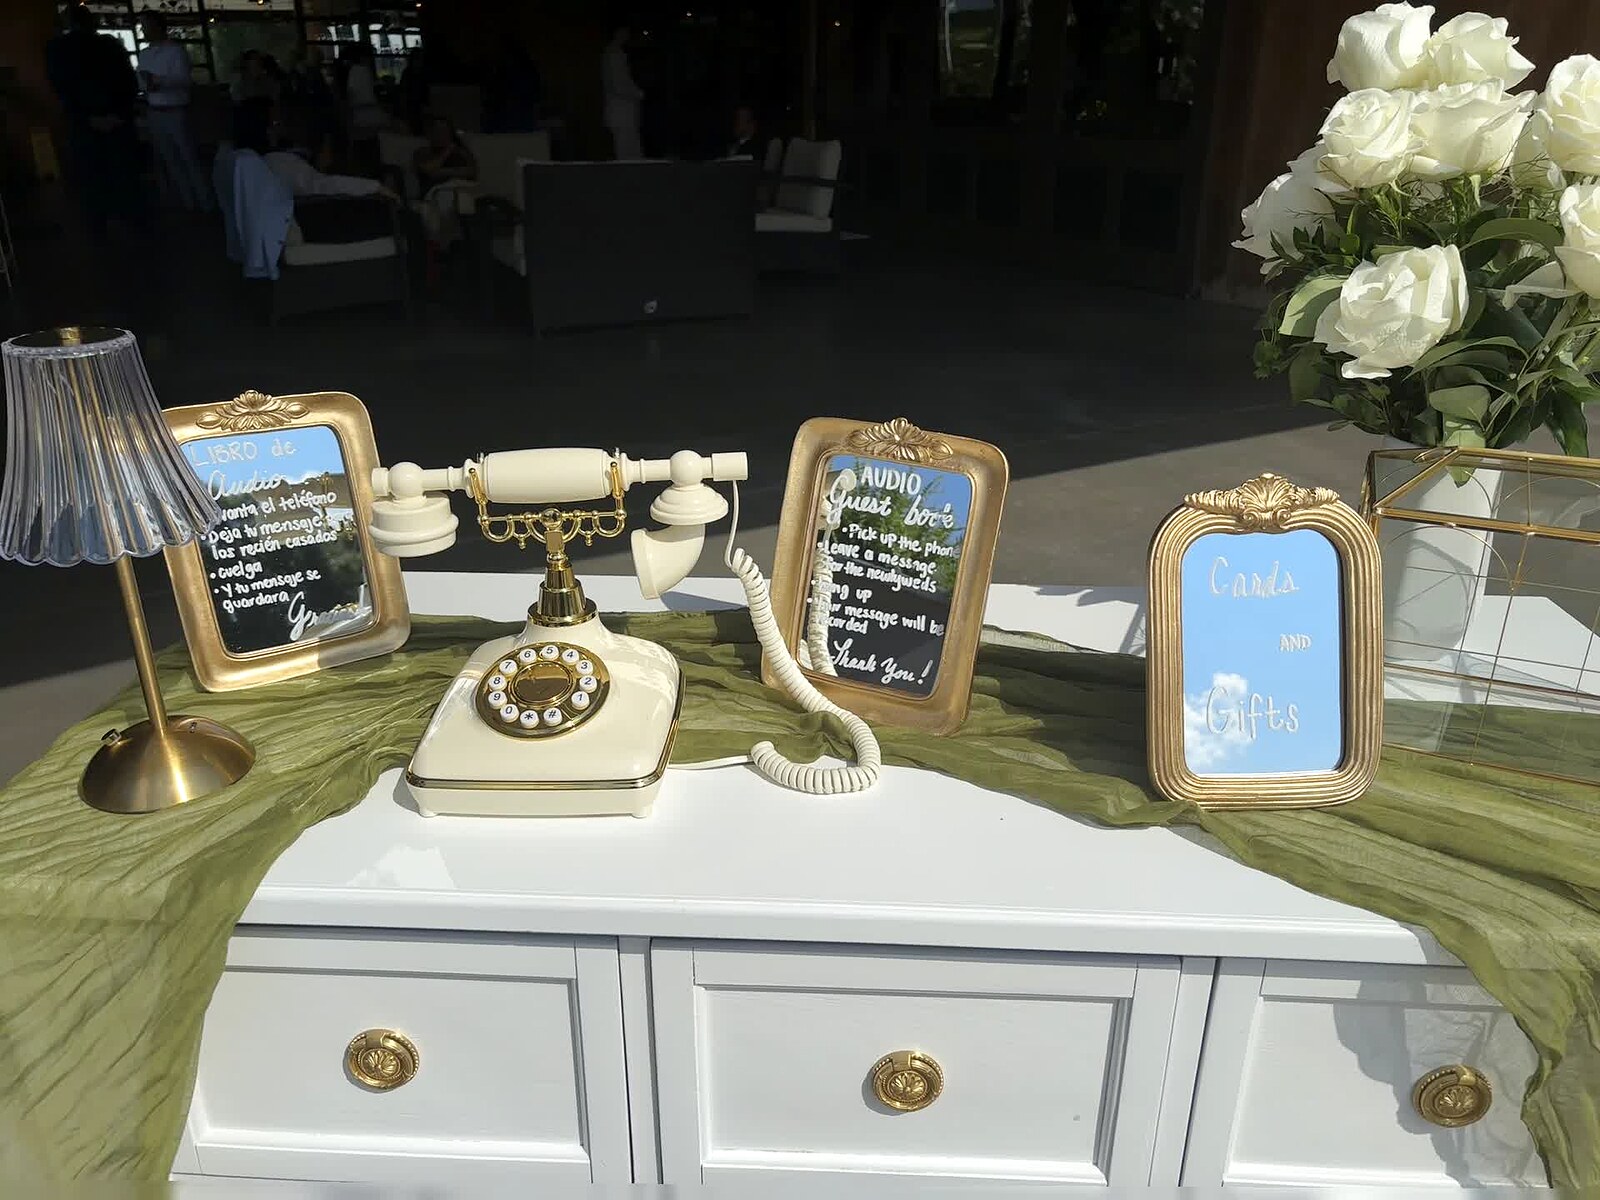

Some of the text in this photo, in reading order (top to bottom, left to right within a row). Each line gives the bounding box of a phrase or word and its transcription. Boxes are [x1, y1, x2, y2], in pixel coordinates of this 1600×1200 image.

[190, 438, 297, 466] LIBRO de
[860, 466, 922, 495] AUDIO
[261, 496, 275, 514] el
[244, 524, 258, 537] tu
[260, 515, 323, 537] mensaje
[211, 545, 236, 560] los
[285, 530, 338, 548] casados
[823, 540, 860, 559] Leave
[864, 549, 874, 561] a
[849, 524, 961, 559] Pick up the phone
[235, 582, 250, 595] tu
[250, 570, 304, 592] mensaje
[306, 569, 321, 581] se
[844, 561, 864, 577] the
[1209, 555, 1300, 599] Cards
[856, 588, 872, 603] up
[844, 605, 898, 629] message
[902, 615, 926, 632] will
[930, 620, 945, 636] be
[831, 638, 876, 672] Thank
[1279, 633, 1312, 652] AND
[1206, 685, 1300, 740] Gifts
